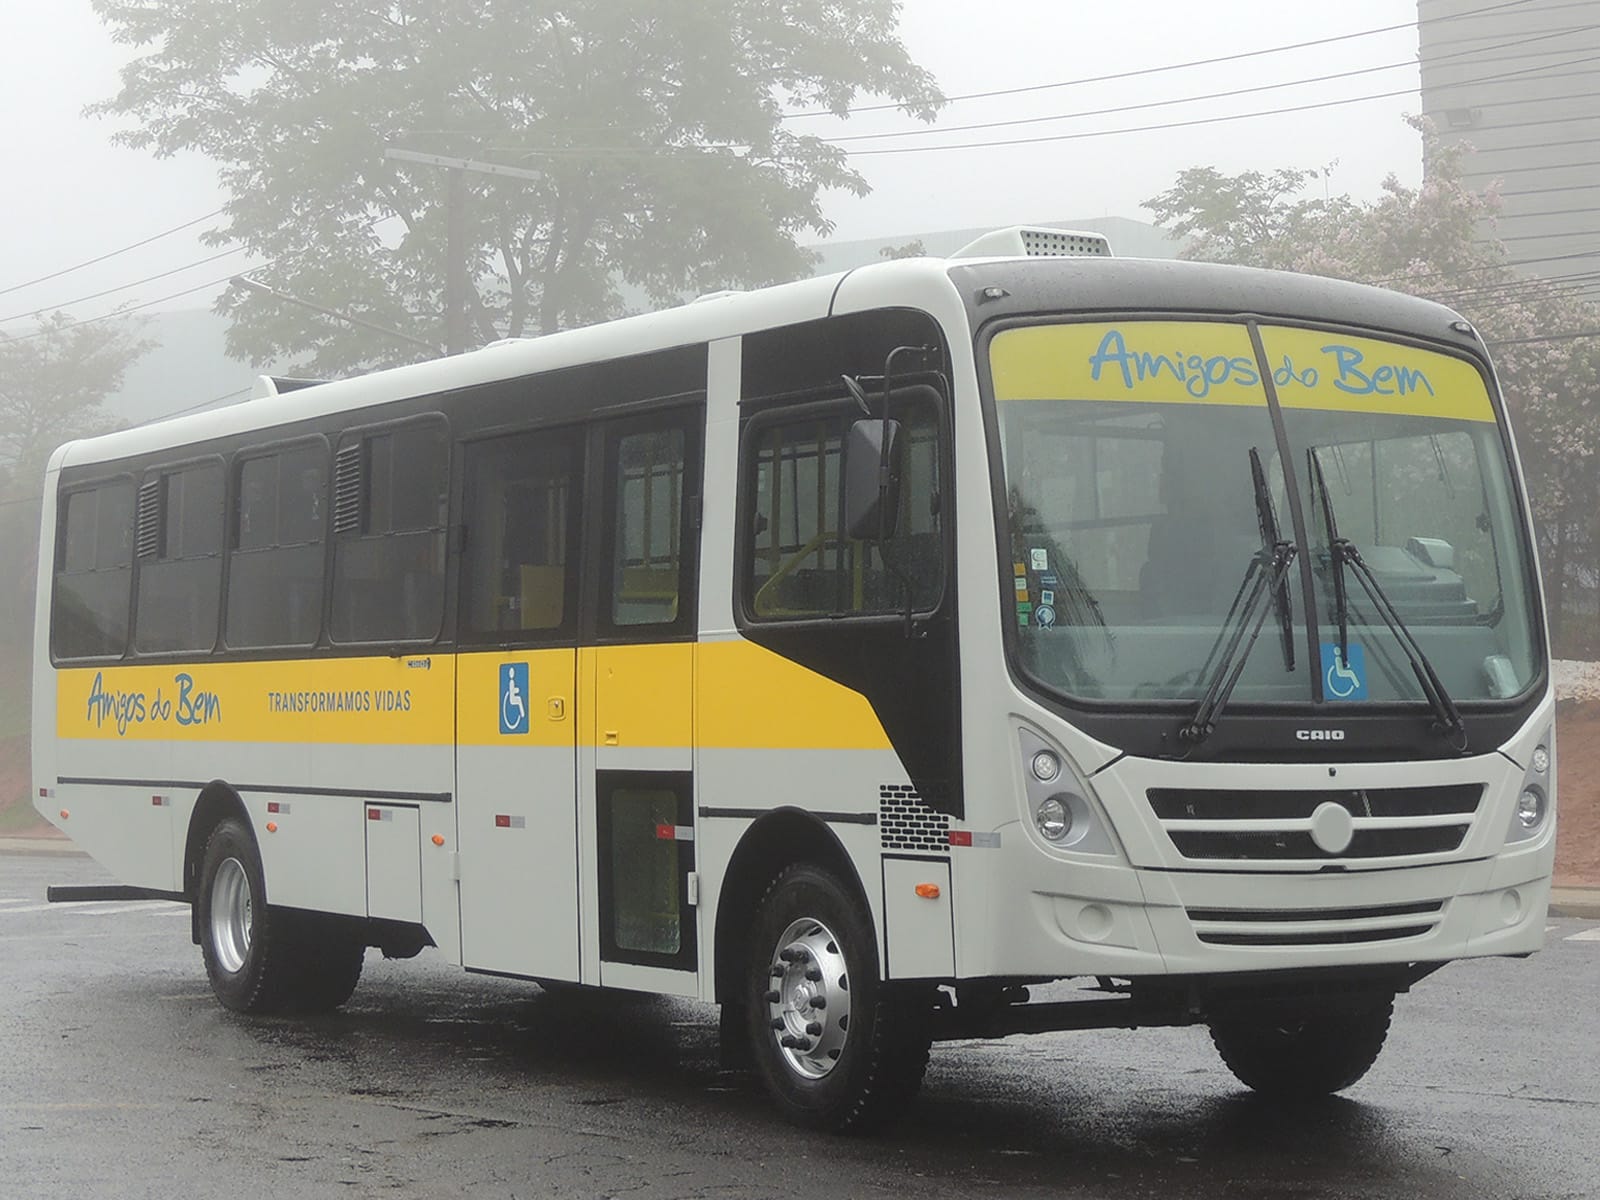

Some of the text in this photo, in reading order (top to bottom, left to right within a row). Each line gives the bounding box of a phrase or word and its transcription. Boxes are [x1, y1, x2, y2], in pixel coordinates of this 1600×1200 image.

[1088, 330, 1435, 397] Amigos do Bem
[87, 671, 222, 736] Amigos do Bem
[268, 690, 412, 713] TRANSFORMAMOS VIDAS
[1296, 730, 1345, 740] CAIO
